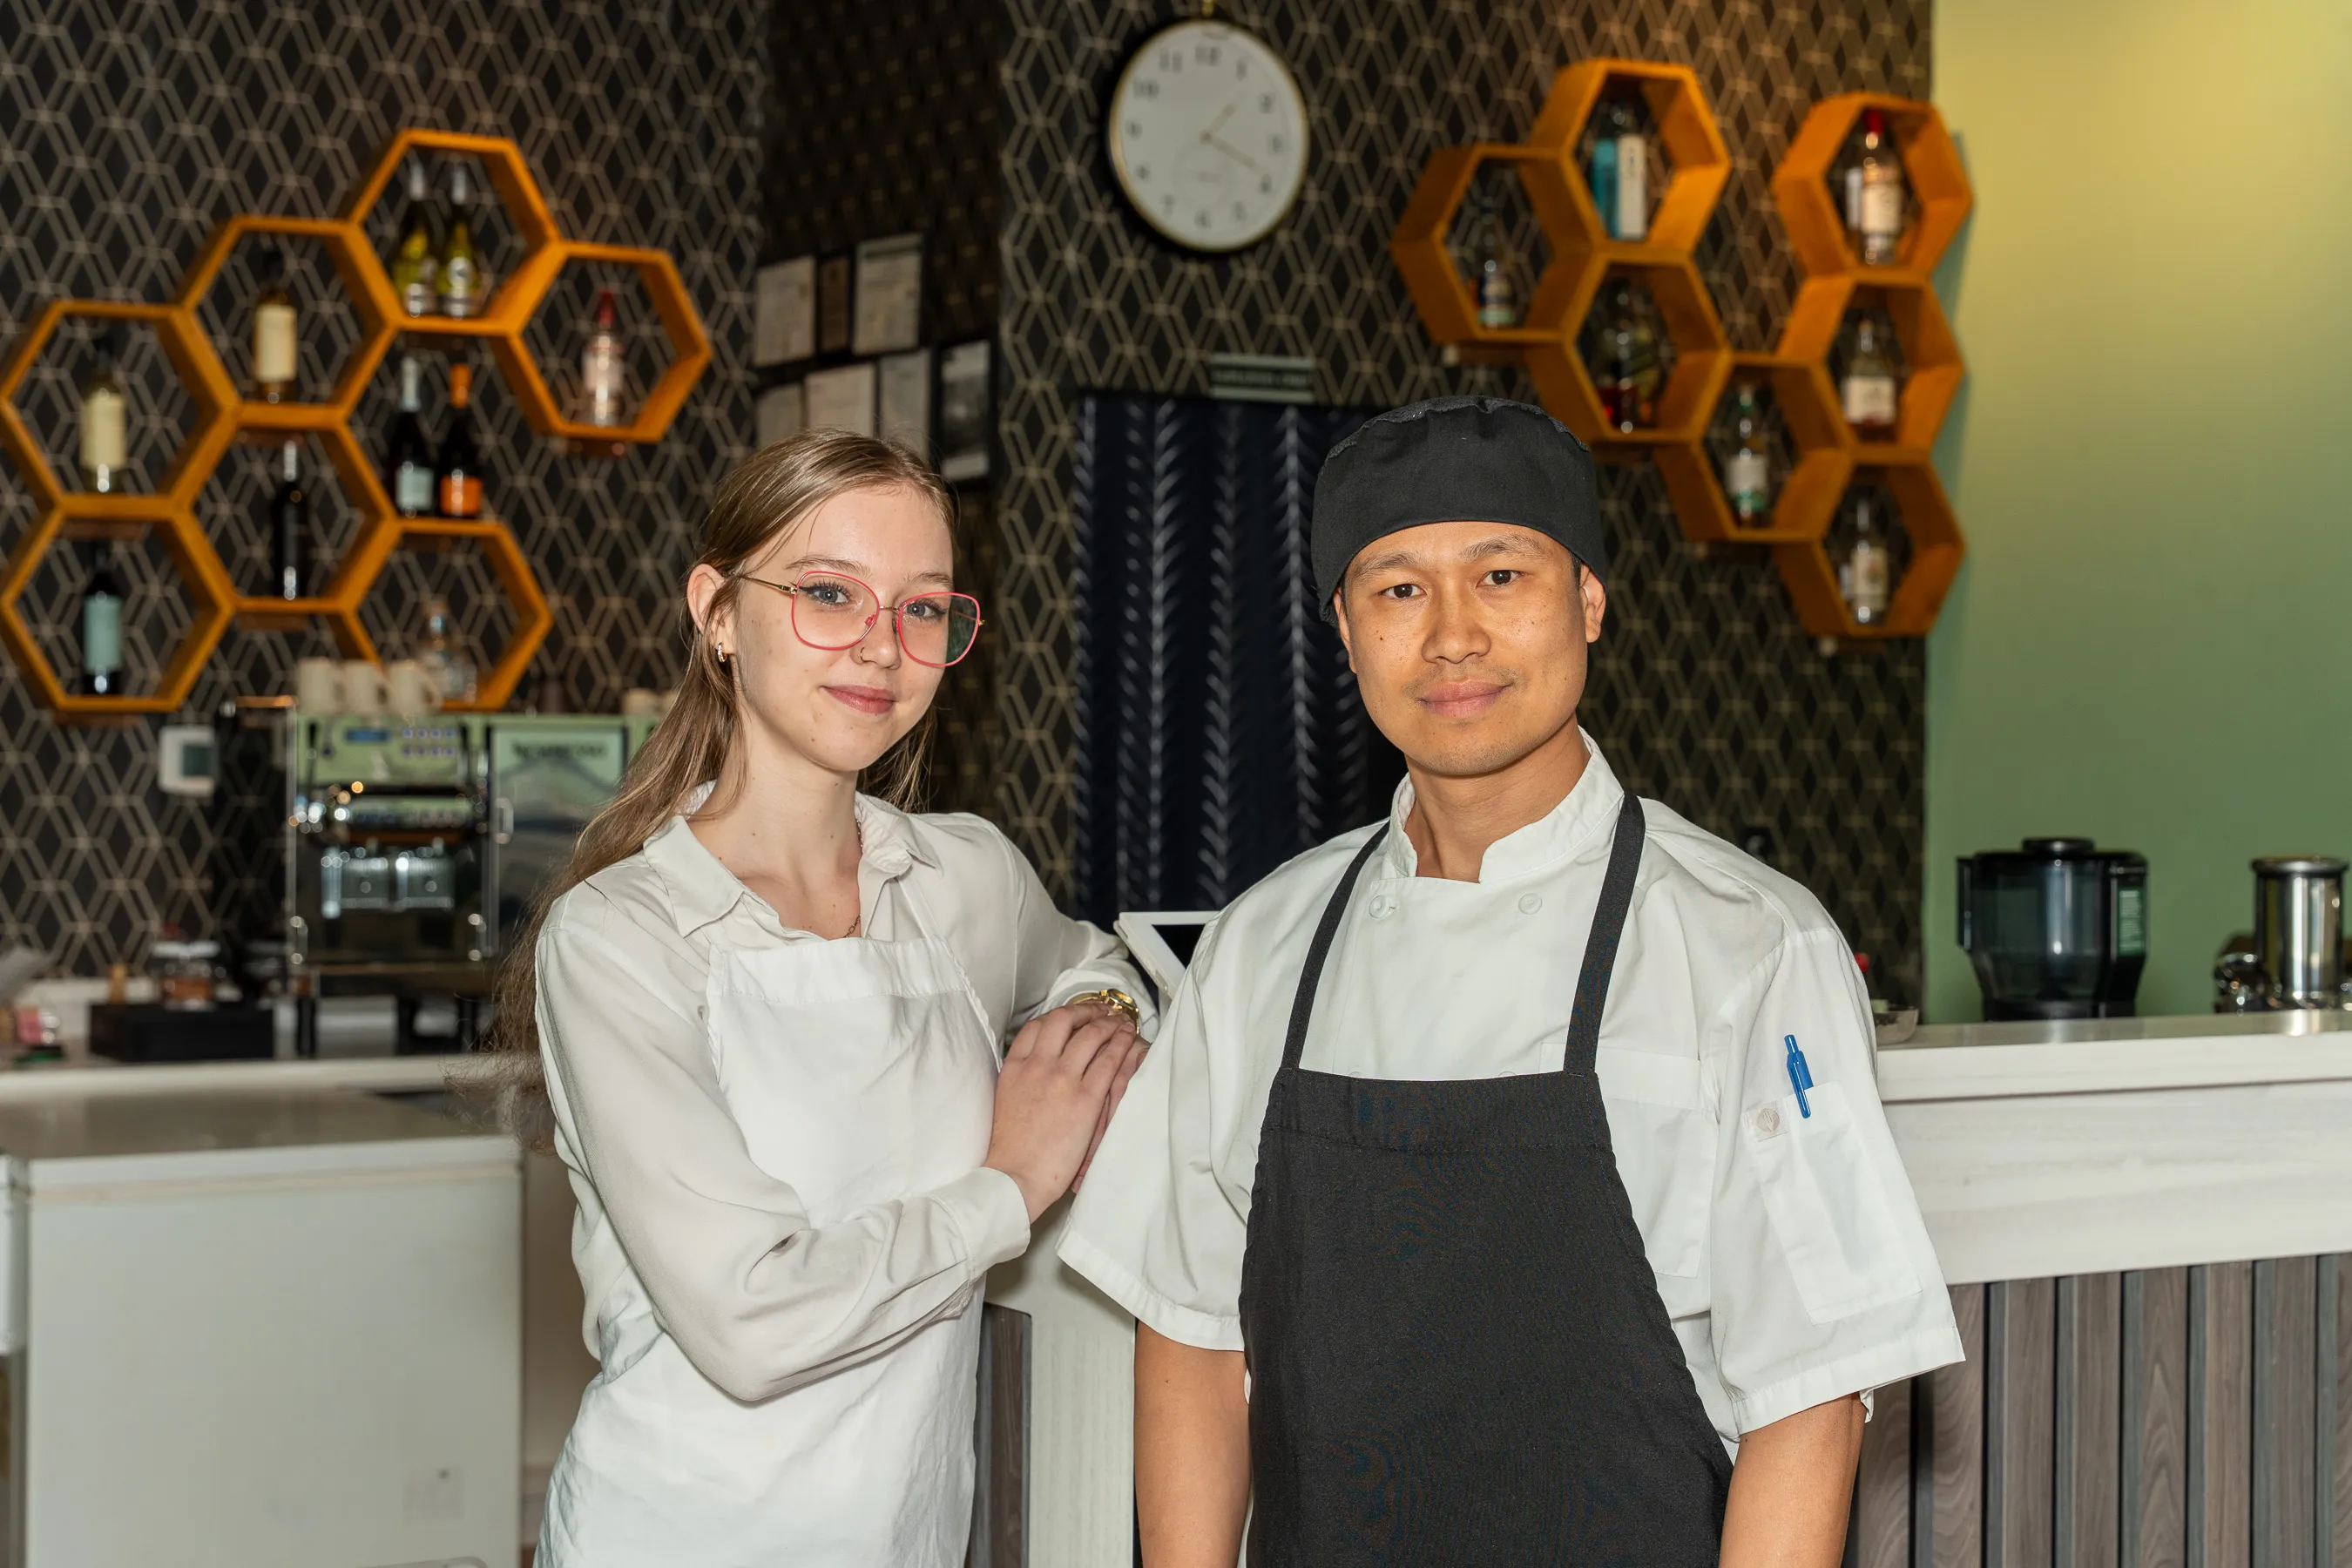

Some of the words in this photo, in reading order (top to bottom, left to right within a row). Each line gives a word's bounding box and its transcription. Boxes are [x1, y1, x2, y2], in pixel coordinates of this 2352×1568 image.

[1159, 50, 1182, 72] 11
[1196, 46, 1220, 65] 12
[1134, 79, 1159, 100] 10
[1260, 92, 1275, 113] 2
[1160, 193, 1173, 214] 7
